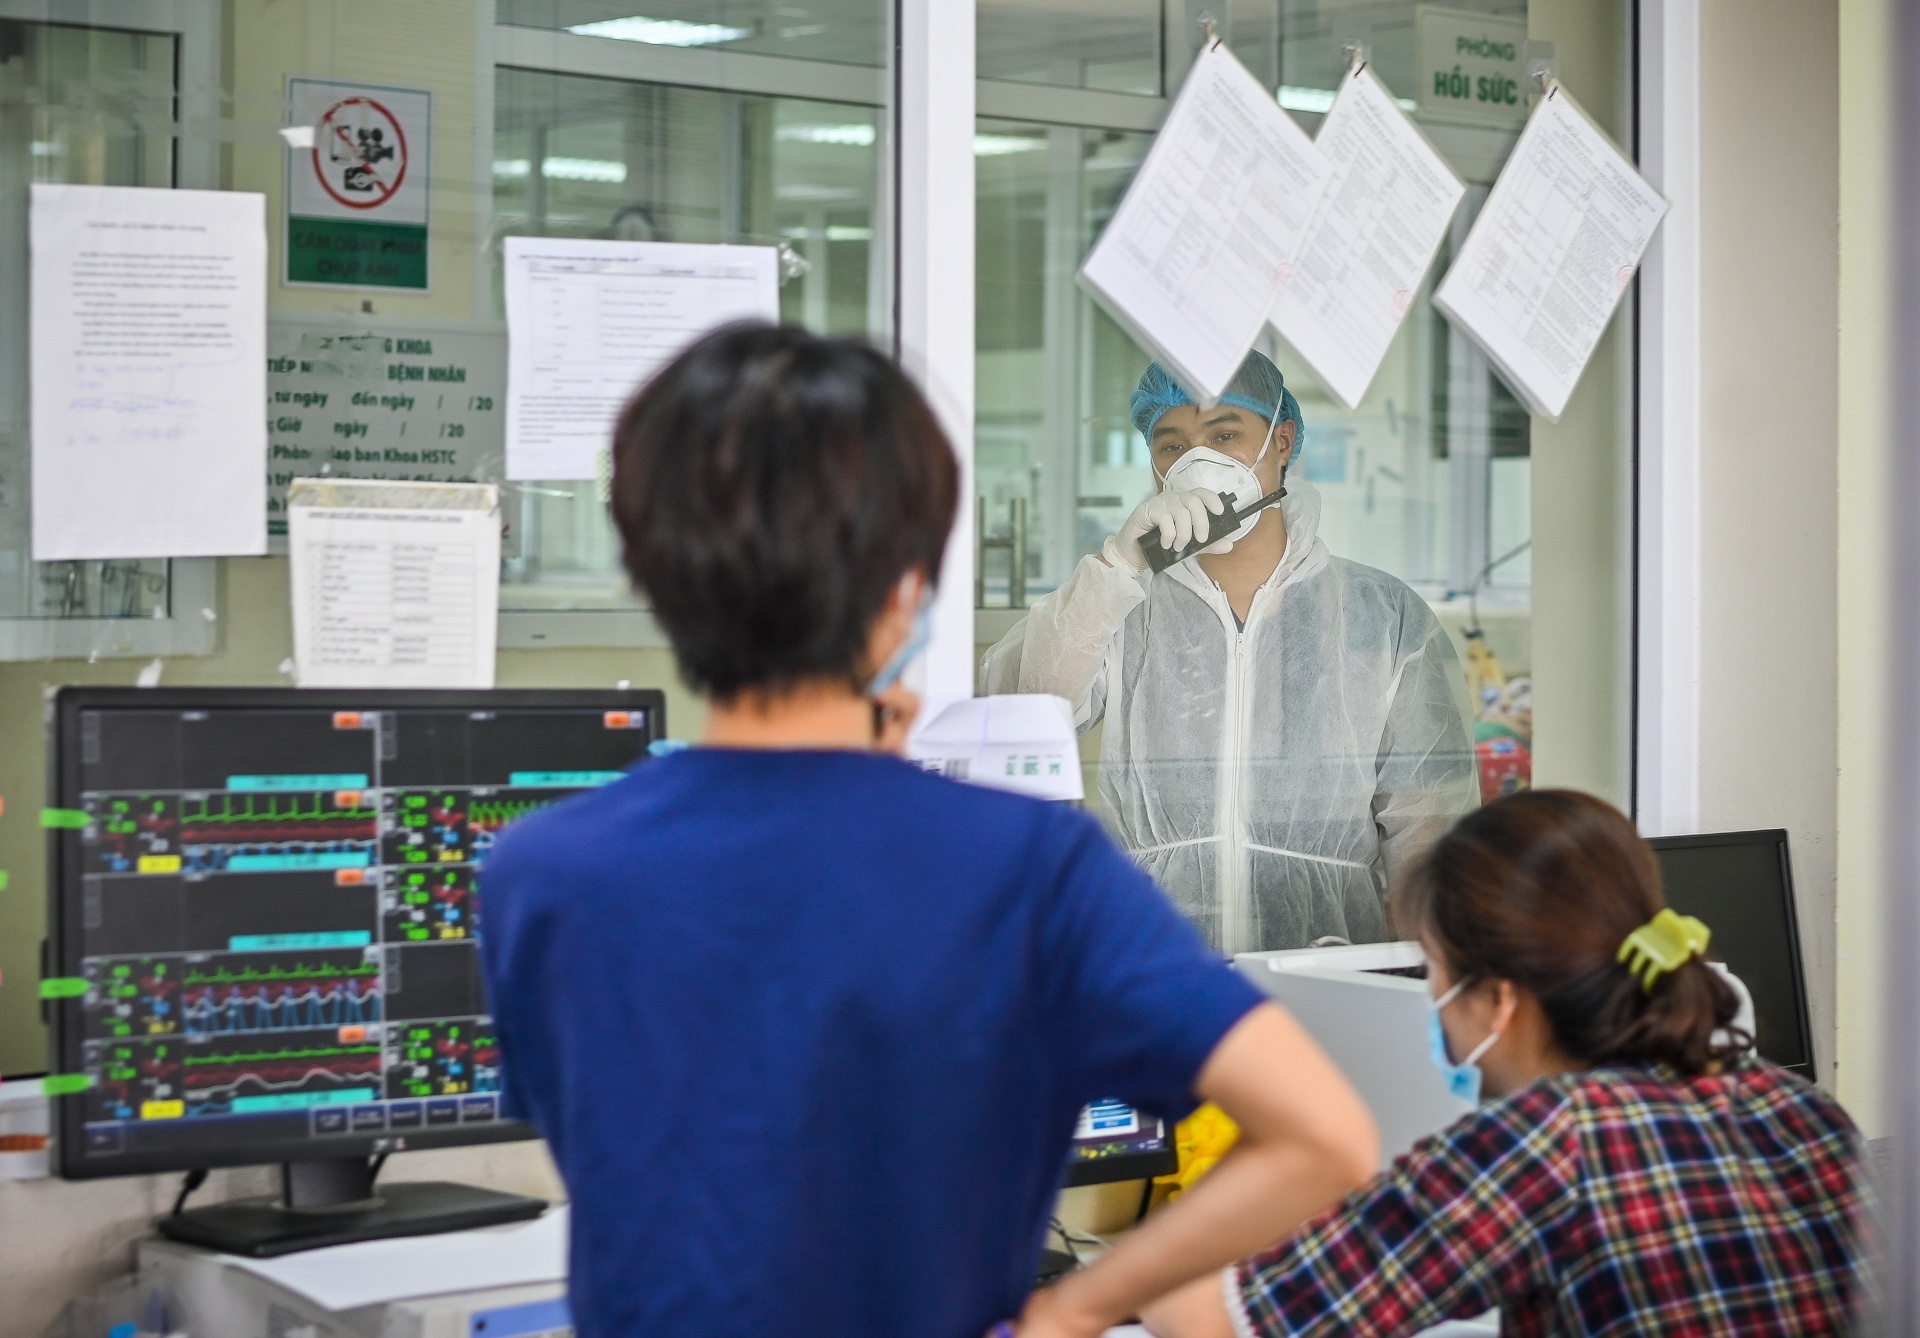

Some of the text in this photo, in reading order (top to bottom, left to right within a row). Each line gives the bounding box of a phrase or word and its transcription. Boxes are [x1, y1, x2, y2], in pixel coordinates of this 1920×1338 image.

[1455, 33, 1516, 61] PHÒNG
[1477, 72, 1518, 105] SỨC
[396, 339, 433, 355] KHOA
[387, 361, 425, 382] BỆNH
[428, 363, 467, 383] NHÂN
[293, 391, 328, 408] ngày
[381, 394, 415, 411] ngày
[333, 420, 369, 438] ngày
[355, 446, 381, 462] ban
[384, 446, 418, 463] Khoa
[421, 448, 456, 465] HSTC
